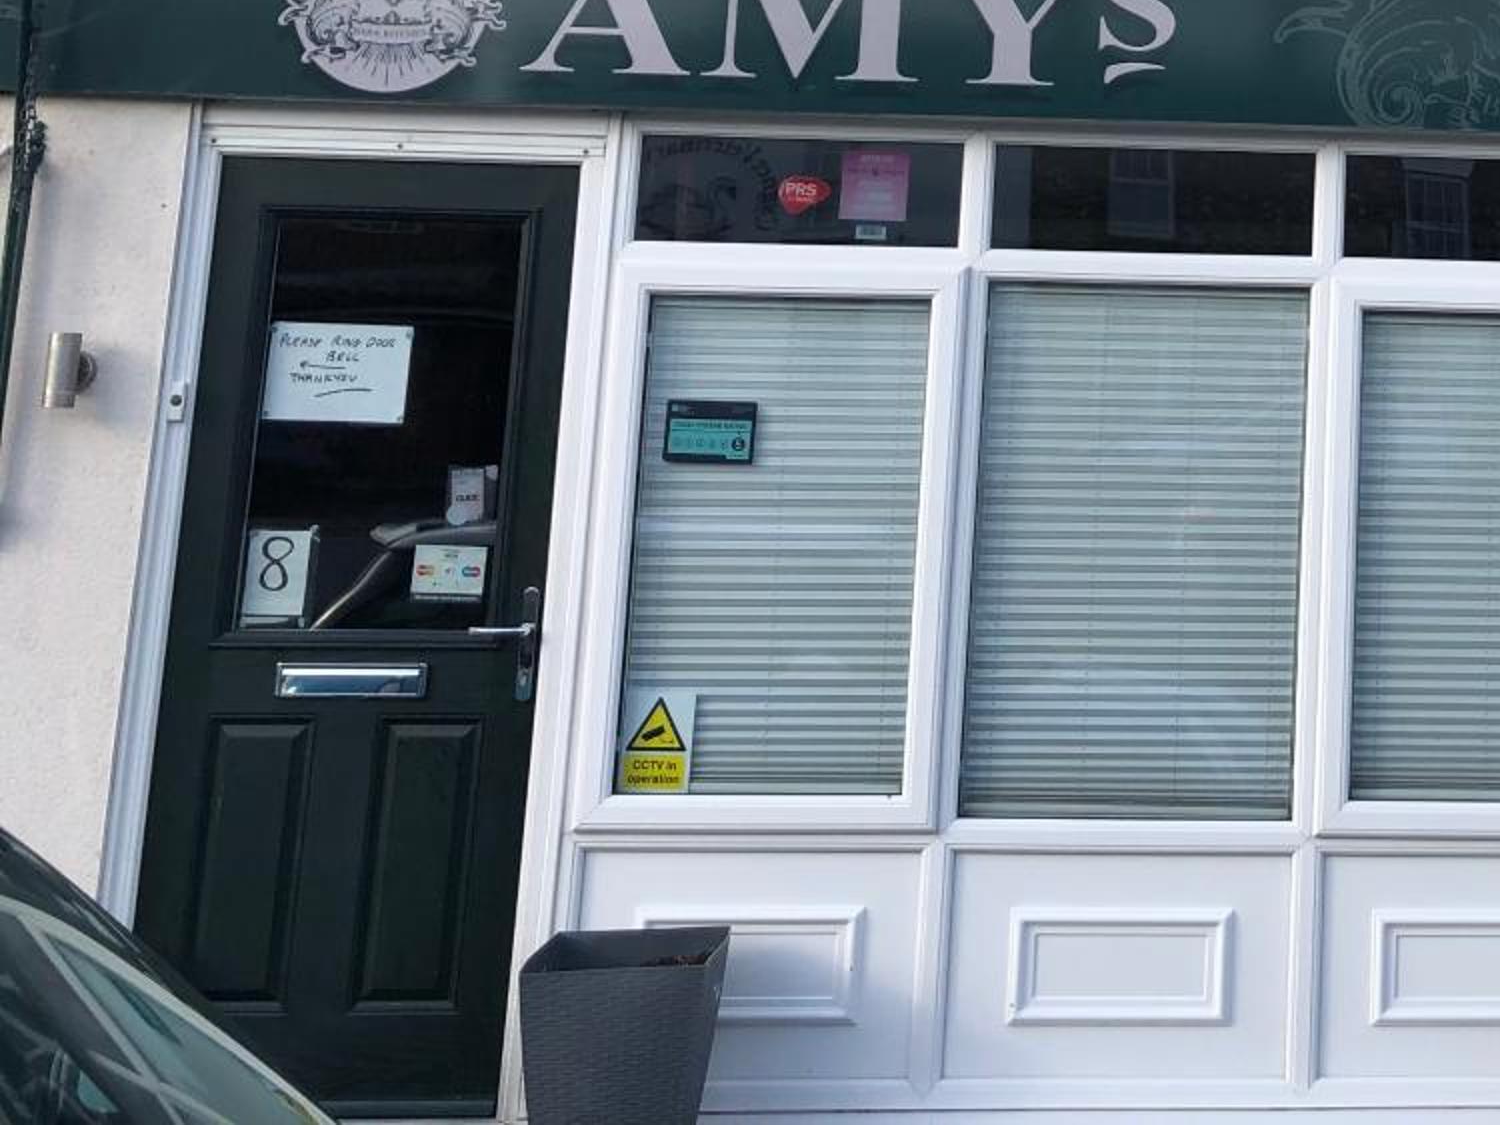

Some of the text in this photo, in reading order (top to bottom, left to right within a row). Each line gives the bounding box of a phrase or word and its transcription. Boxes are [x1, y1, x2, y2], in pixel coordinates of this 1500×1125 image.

[785, 182, 817, 197] PRS
[326, 350, 360, 362] BELL
[259, 536, 295, 591] 8
[633, 760, 677, 771] CCTV in
